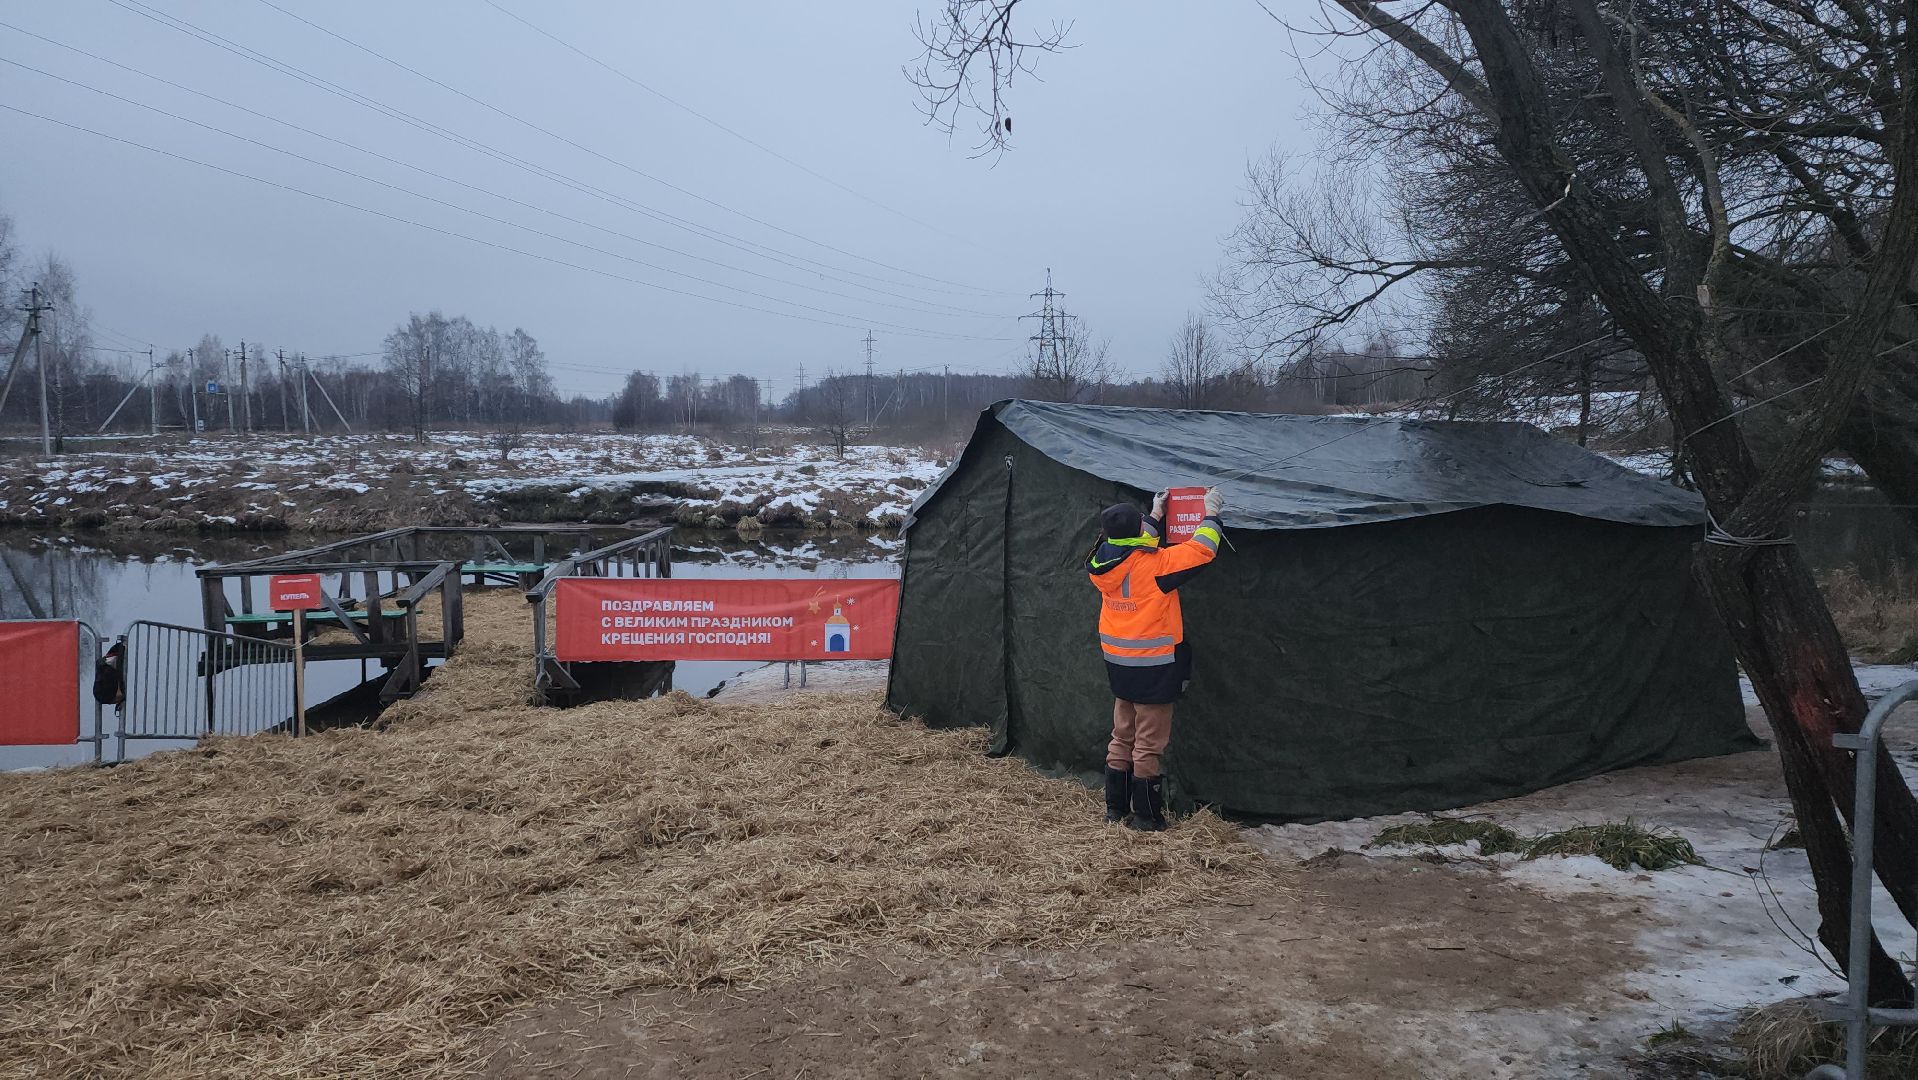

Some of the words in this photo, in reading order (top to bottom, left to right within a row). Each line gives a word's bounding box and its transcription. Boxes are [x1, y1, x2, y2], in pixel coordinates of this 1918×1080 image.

[1176, 513, 1202, 522] ТЕПЛЫЕ
[280, 592, 310, 601] КУПЕЛЬ
[601, 600, 714, 613] ПОЗДРАВЛЯЕМ
[601, 616, 612, 628] С
[614, 616, 688, 628] ВЕЛИКИМ
[690, 616, 794, 630] ПРАЗДНИКОМ
[601, 632, 685, 646] КРЕЩЕНИЯ
[688, 632, 771, 646] ГОСПОДНЯ!
